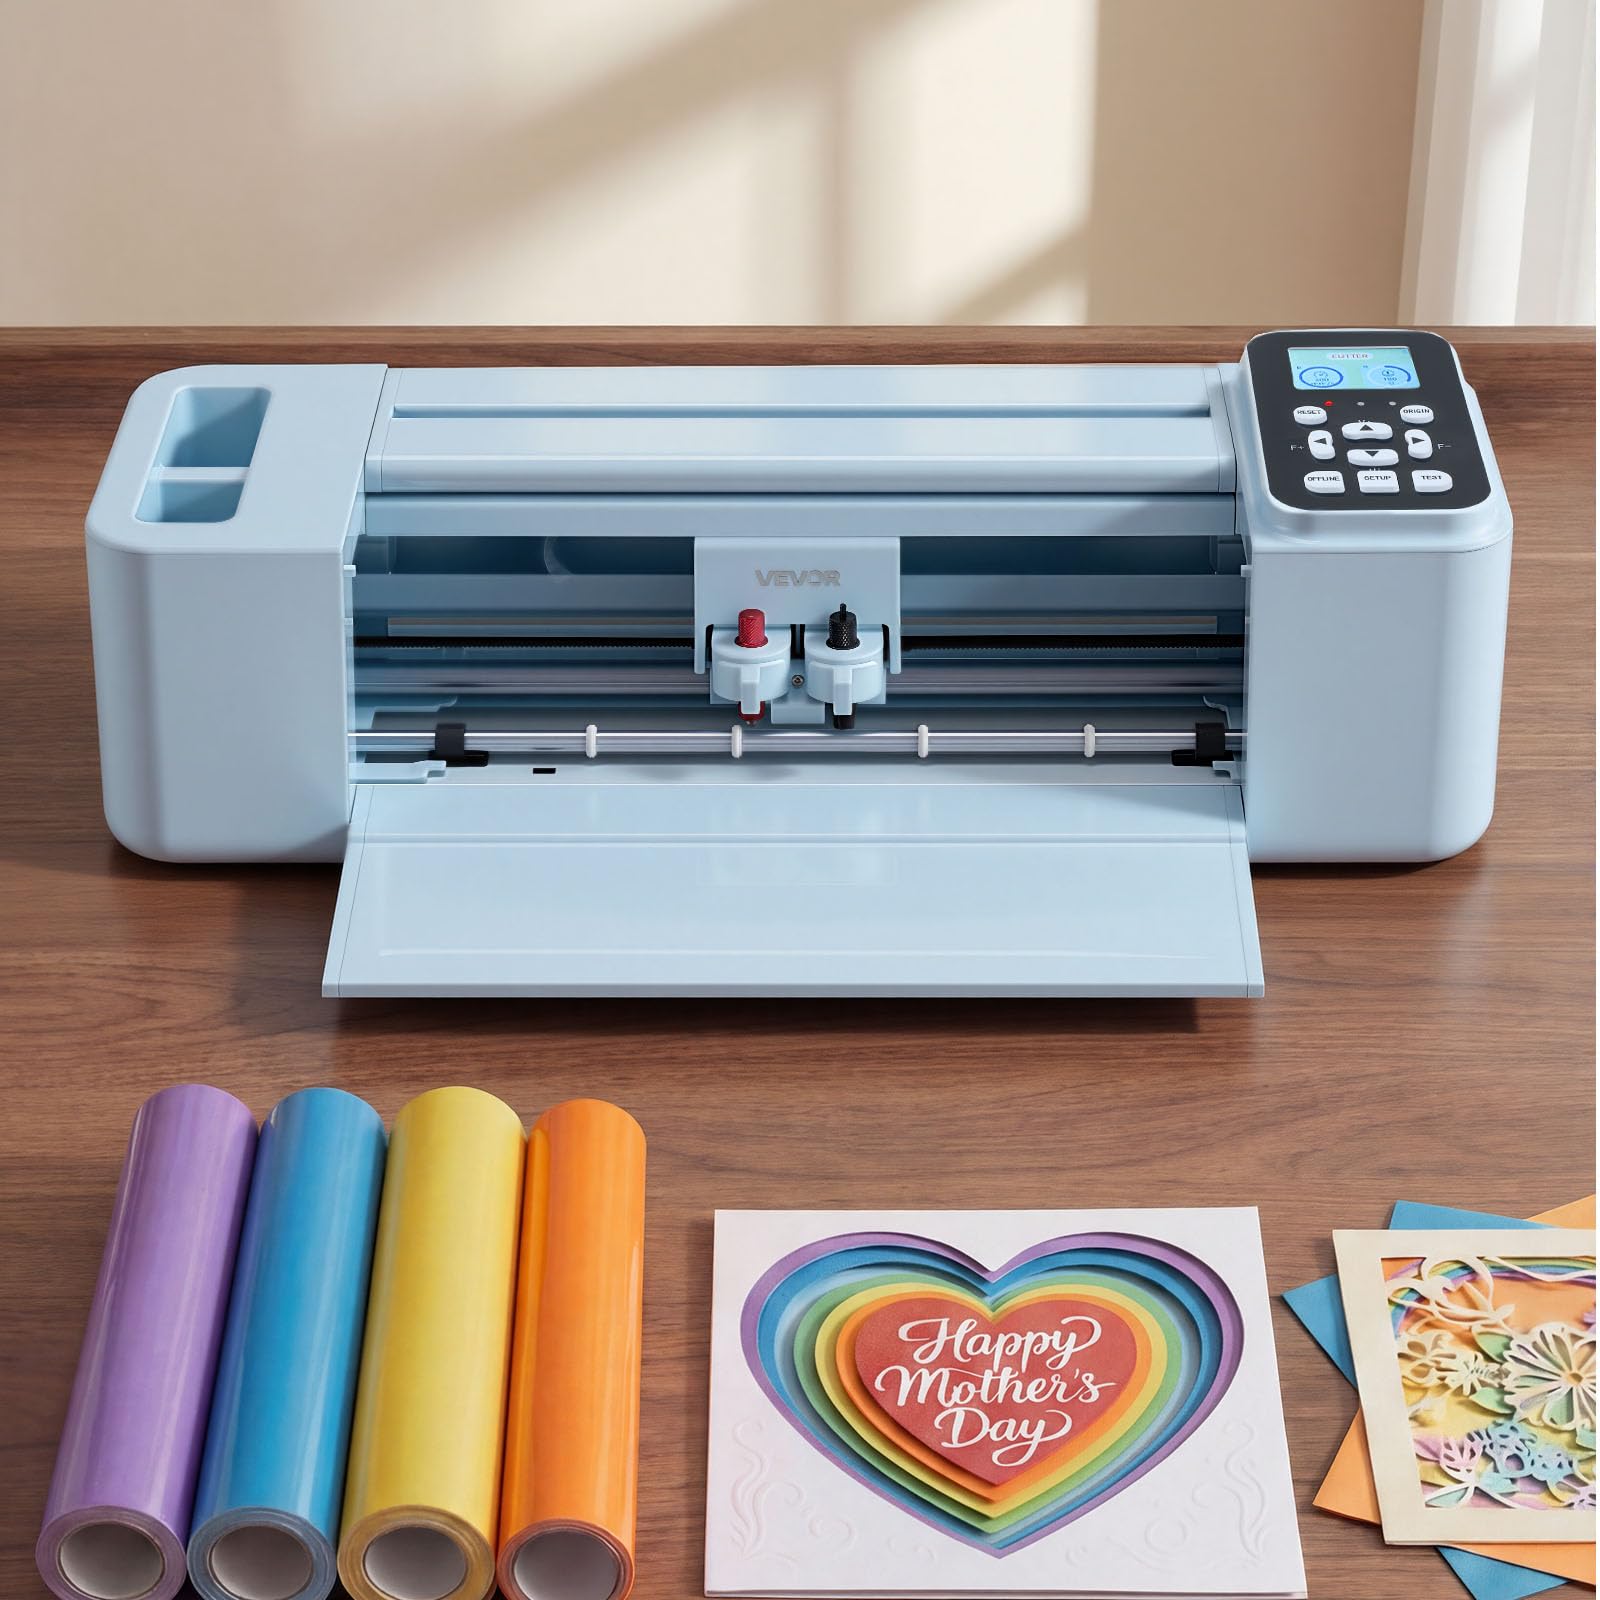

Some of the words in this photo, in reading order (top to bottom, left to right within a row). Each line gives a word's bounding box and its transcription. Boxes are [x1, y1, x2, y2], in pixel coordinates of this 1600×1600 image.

[755, 569, 841, 587] VEVOR
[898, 1315, 1102, 1373] Happy
[874, 1364, 1118, 1408] Mother's
[933, 1407, 1073, 1467] Day
